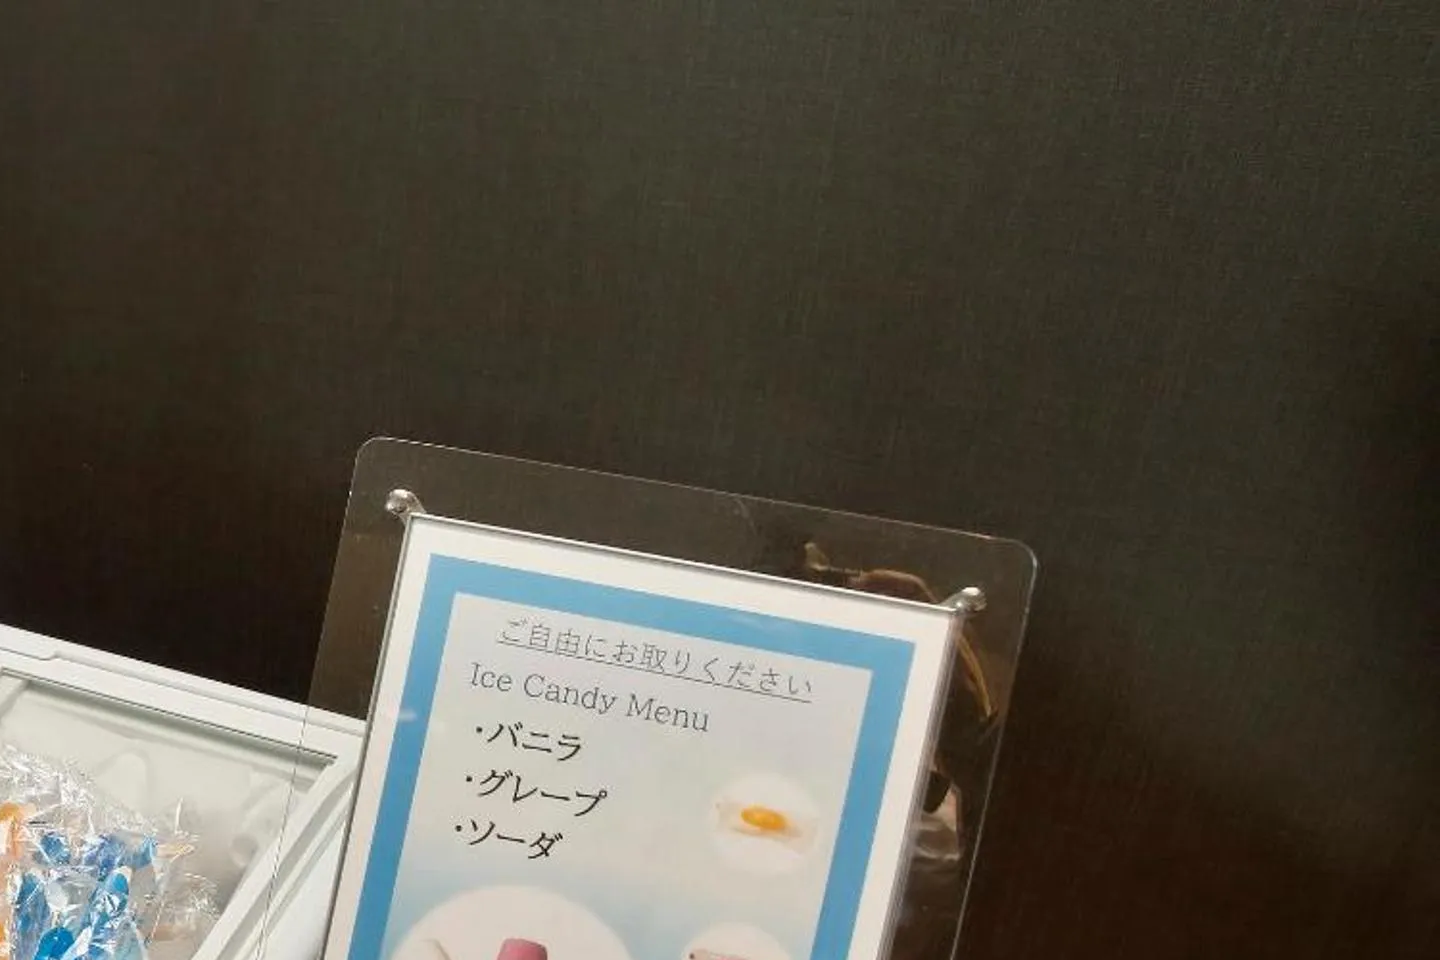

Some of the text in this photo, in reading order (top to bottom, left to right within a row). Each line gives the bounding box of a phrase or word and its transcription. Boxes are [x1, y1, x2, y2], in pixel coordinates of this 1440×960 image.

[501, 617, 812, 696] ご自由にお取りください
[470, 661, 710, 733] Ice Candy Menu
